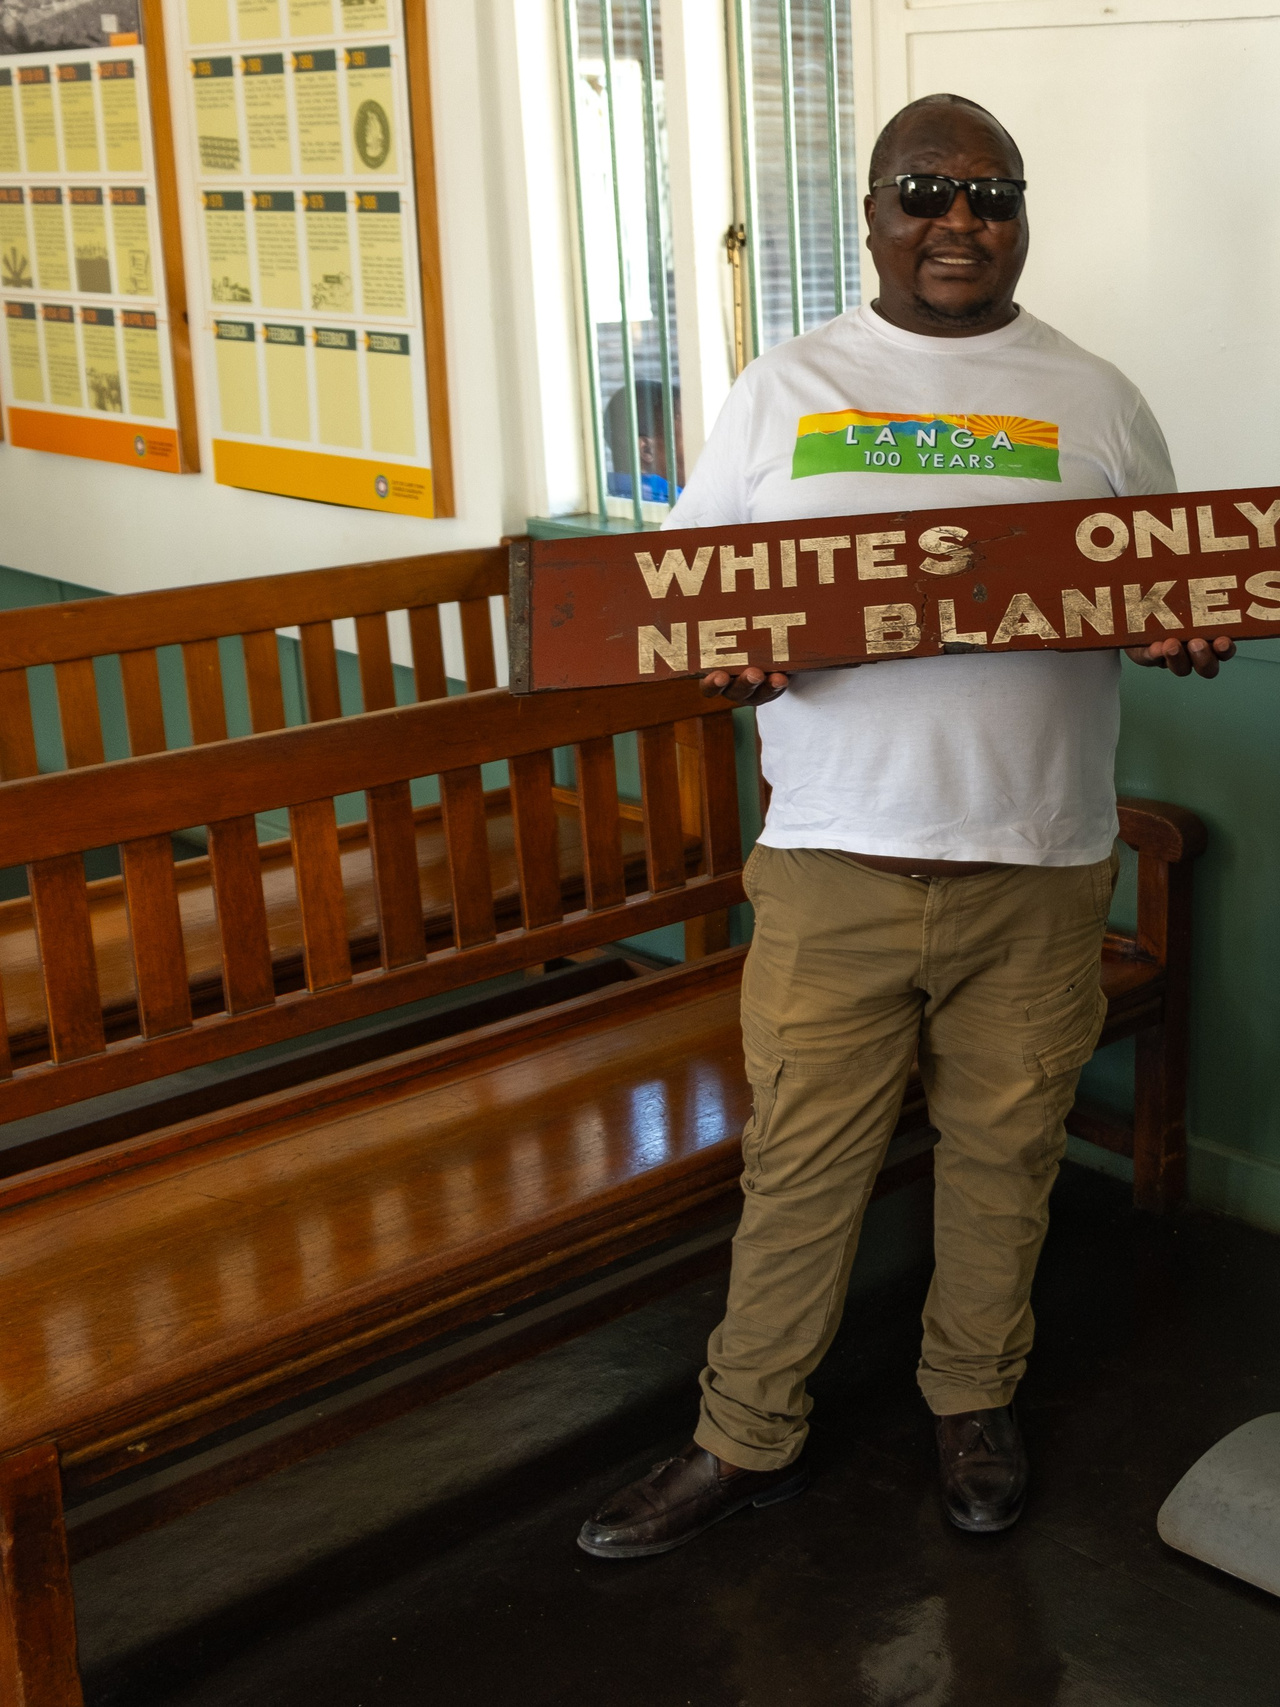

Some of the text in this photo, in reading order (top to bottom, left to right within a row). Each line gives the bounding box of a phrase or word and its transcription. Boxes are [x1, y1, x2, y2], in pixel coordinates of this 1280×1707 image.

[218, 323, 247, 338] FEEDBACK
[267, 326, 297, 342] FEEDBACK
[317, 331, 348, 347] FEEDBACK
[370, 335, 401, 351] FEEDBACK
[846, 424, 1014, 450] LANGA
[864, 451, 995, 469] 100 YEARS
[634, 525, 974, 599] WHITES
[638, 611, 807, 675] NET
